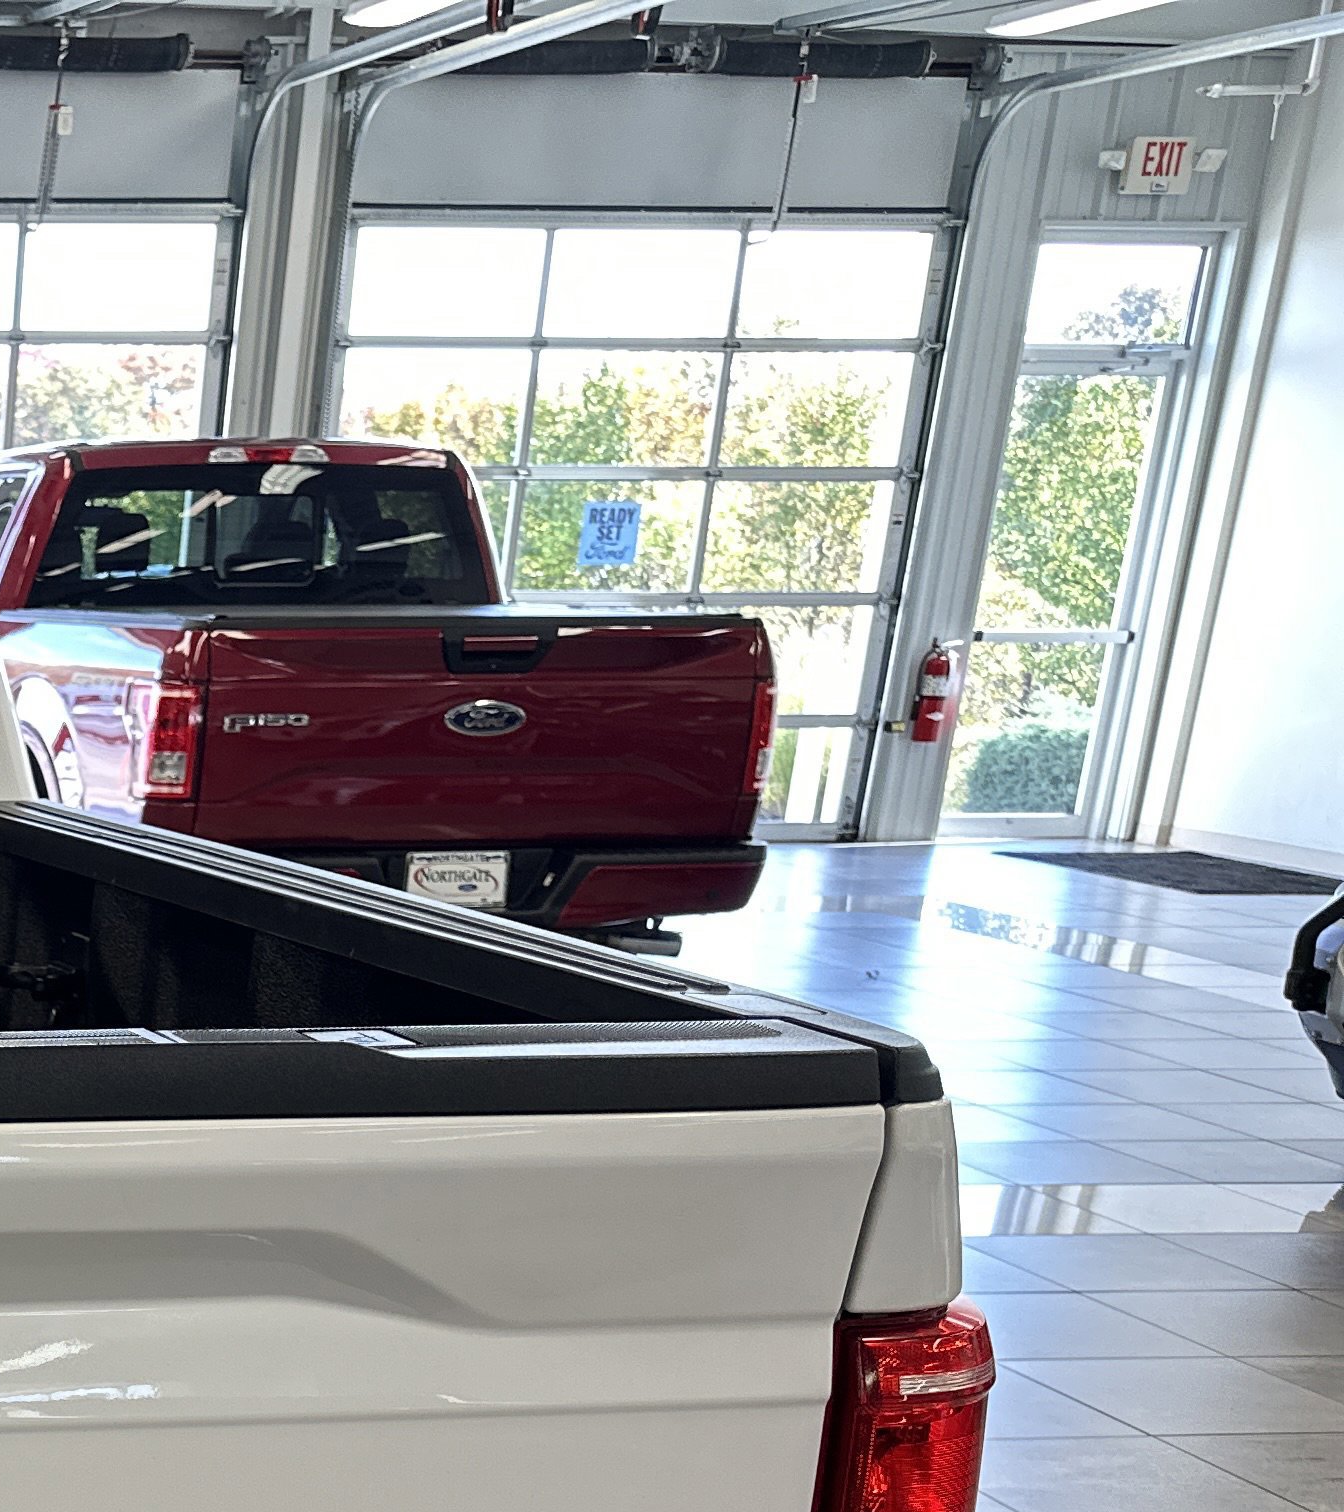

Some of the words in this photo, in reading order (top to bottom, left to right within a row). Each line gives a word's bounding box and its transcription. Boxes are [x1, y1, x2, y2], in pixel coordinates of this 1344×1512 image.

[1141, 141, 1188, 176] EXIT
[589, 508, 636, 524] READY
[596, 525, 624, 541] SET
